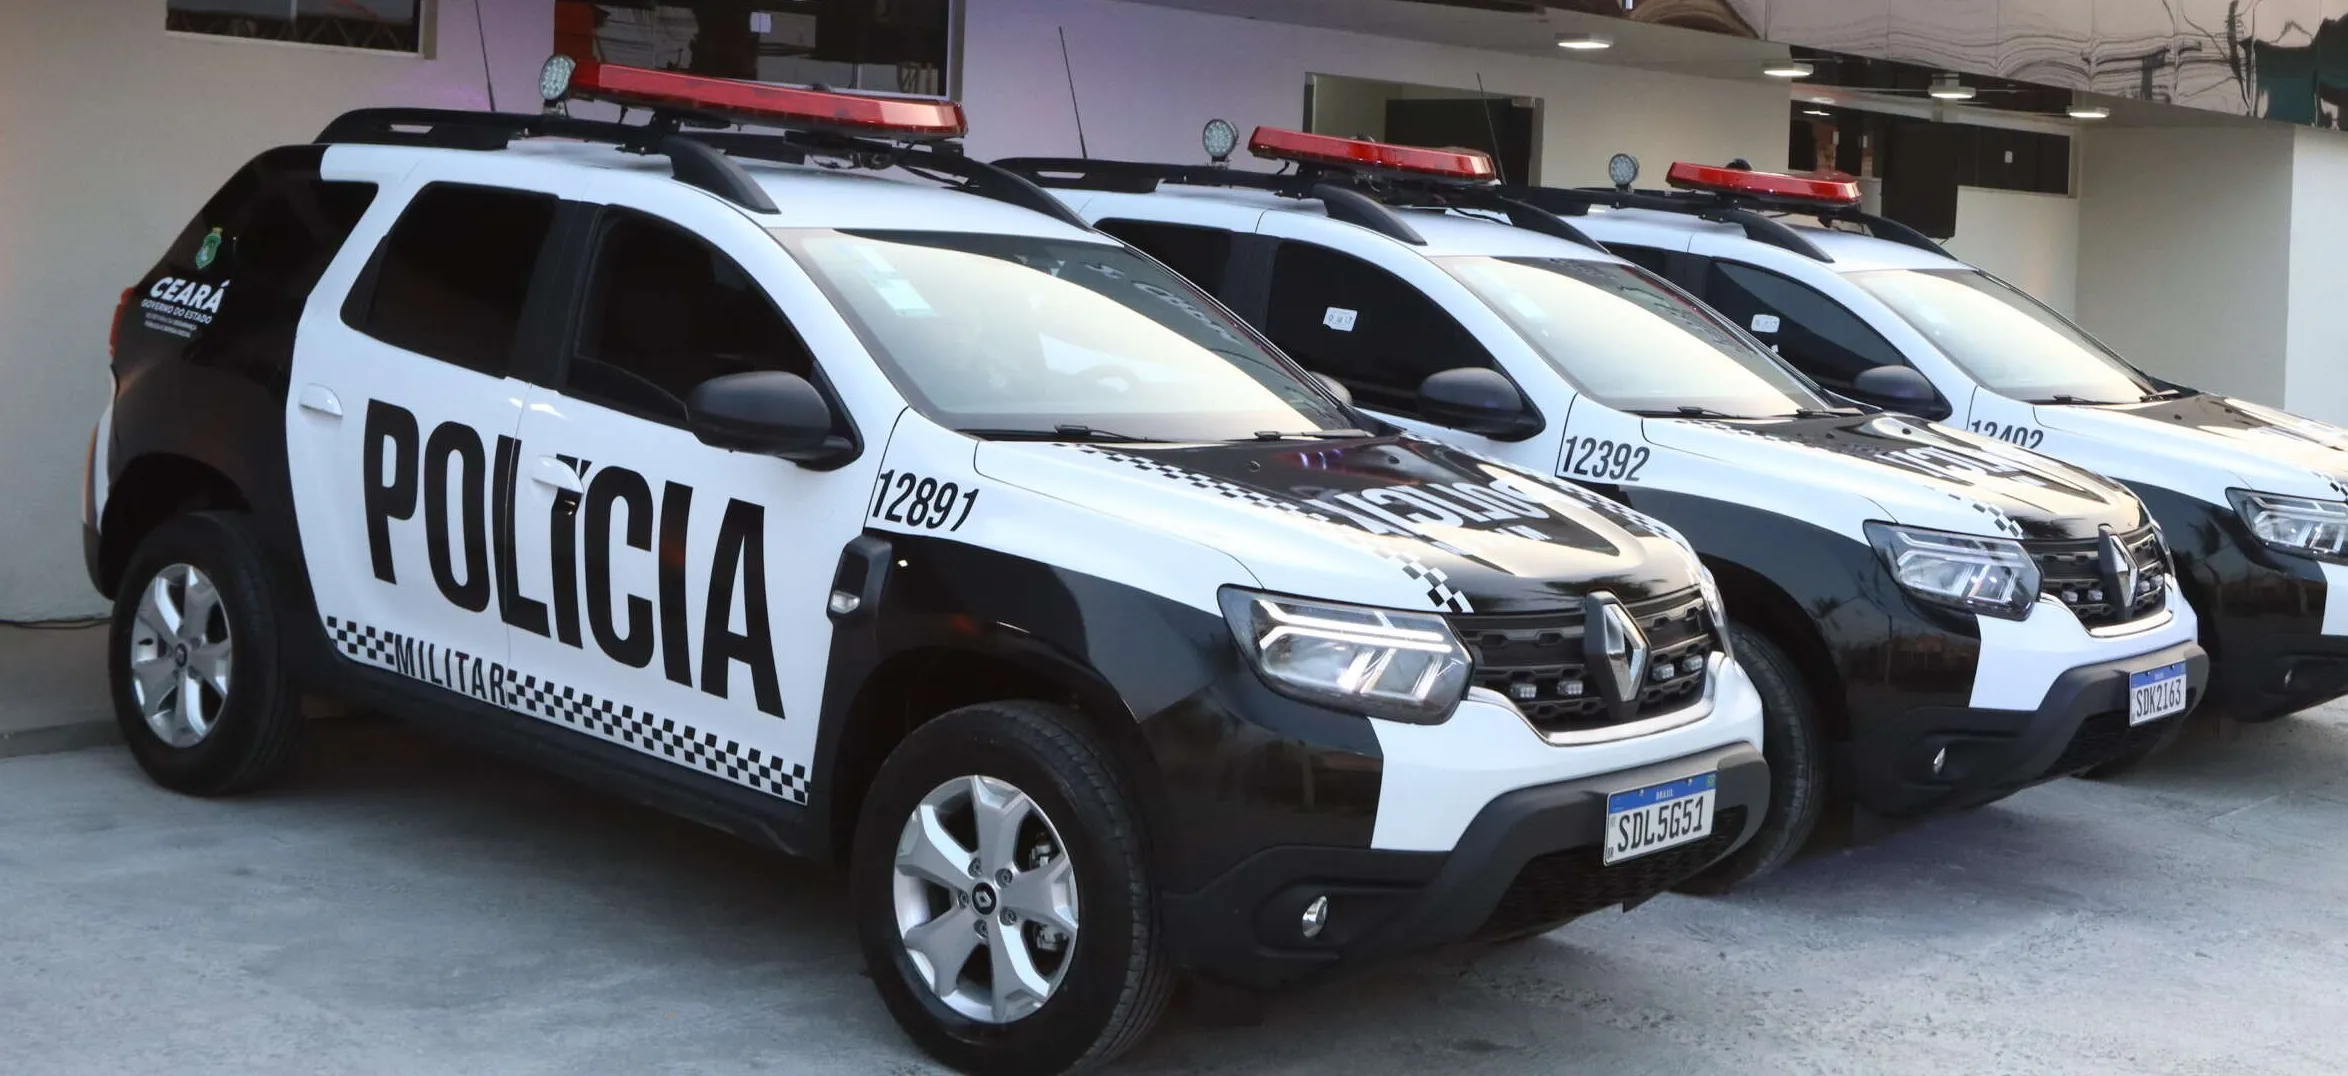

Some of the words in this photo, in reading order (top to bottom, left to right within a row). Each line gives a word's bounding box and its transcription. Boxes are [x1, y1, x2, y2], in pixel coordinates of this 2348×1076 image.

[141, 299, 174, 314] GOVERNO
[173, 307, 186, 317] DO
[184, 310, 212, 325] ESTADO
[150, 277, 230, 313] CEARÁ
[1562, 435, 1650, 482] 12392
[872, 469, 979, 532] 12891
[364, 398, 786, 720] POLÍCIA
[395, 633, 508, 707] MILITAR
[1617, 795, 1704, 853] SDL5G51
